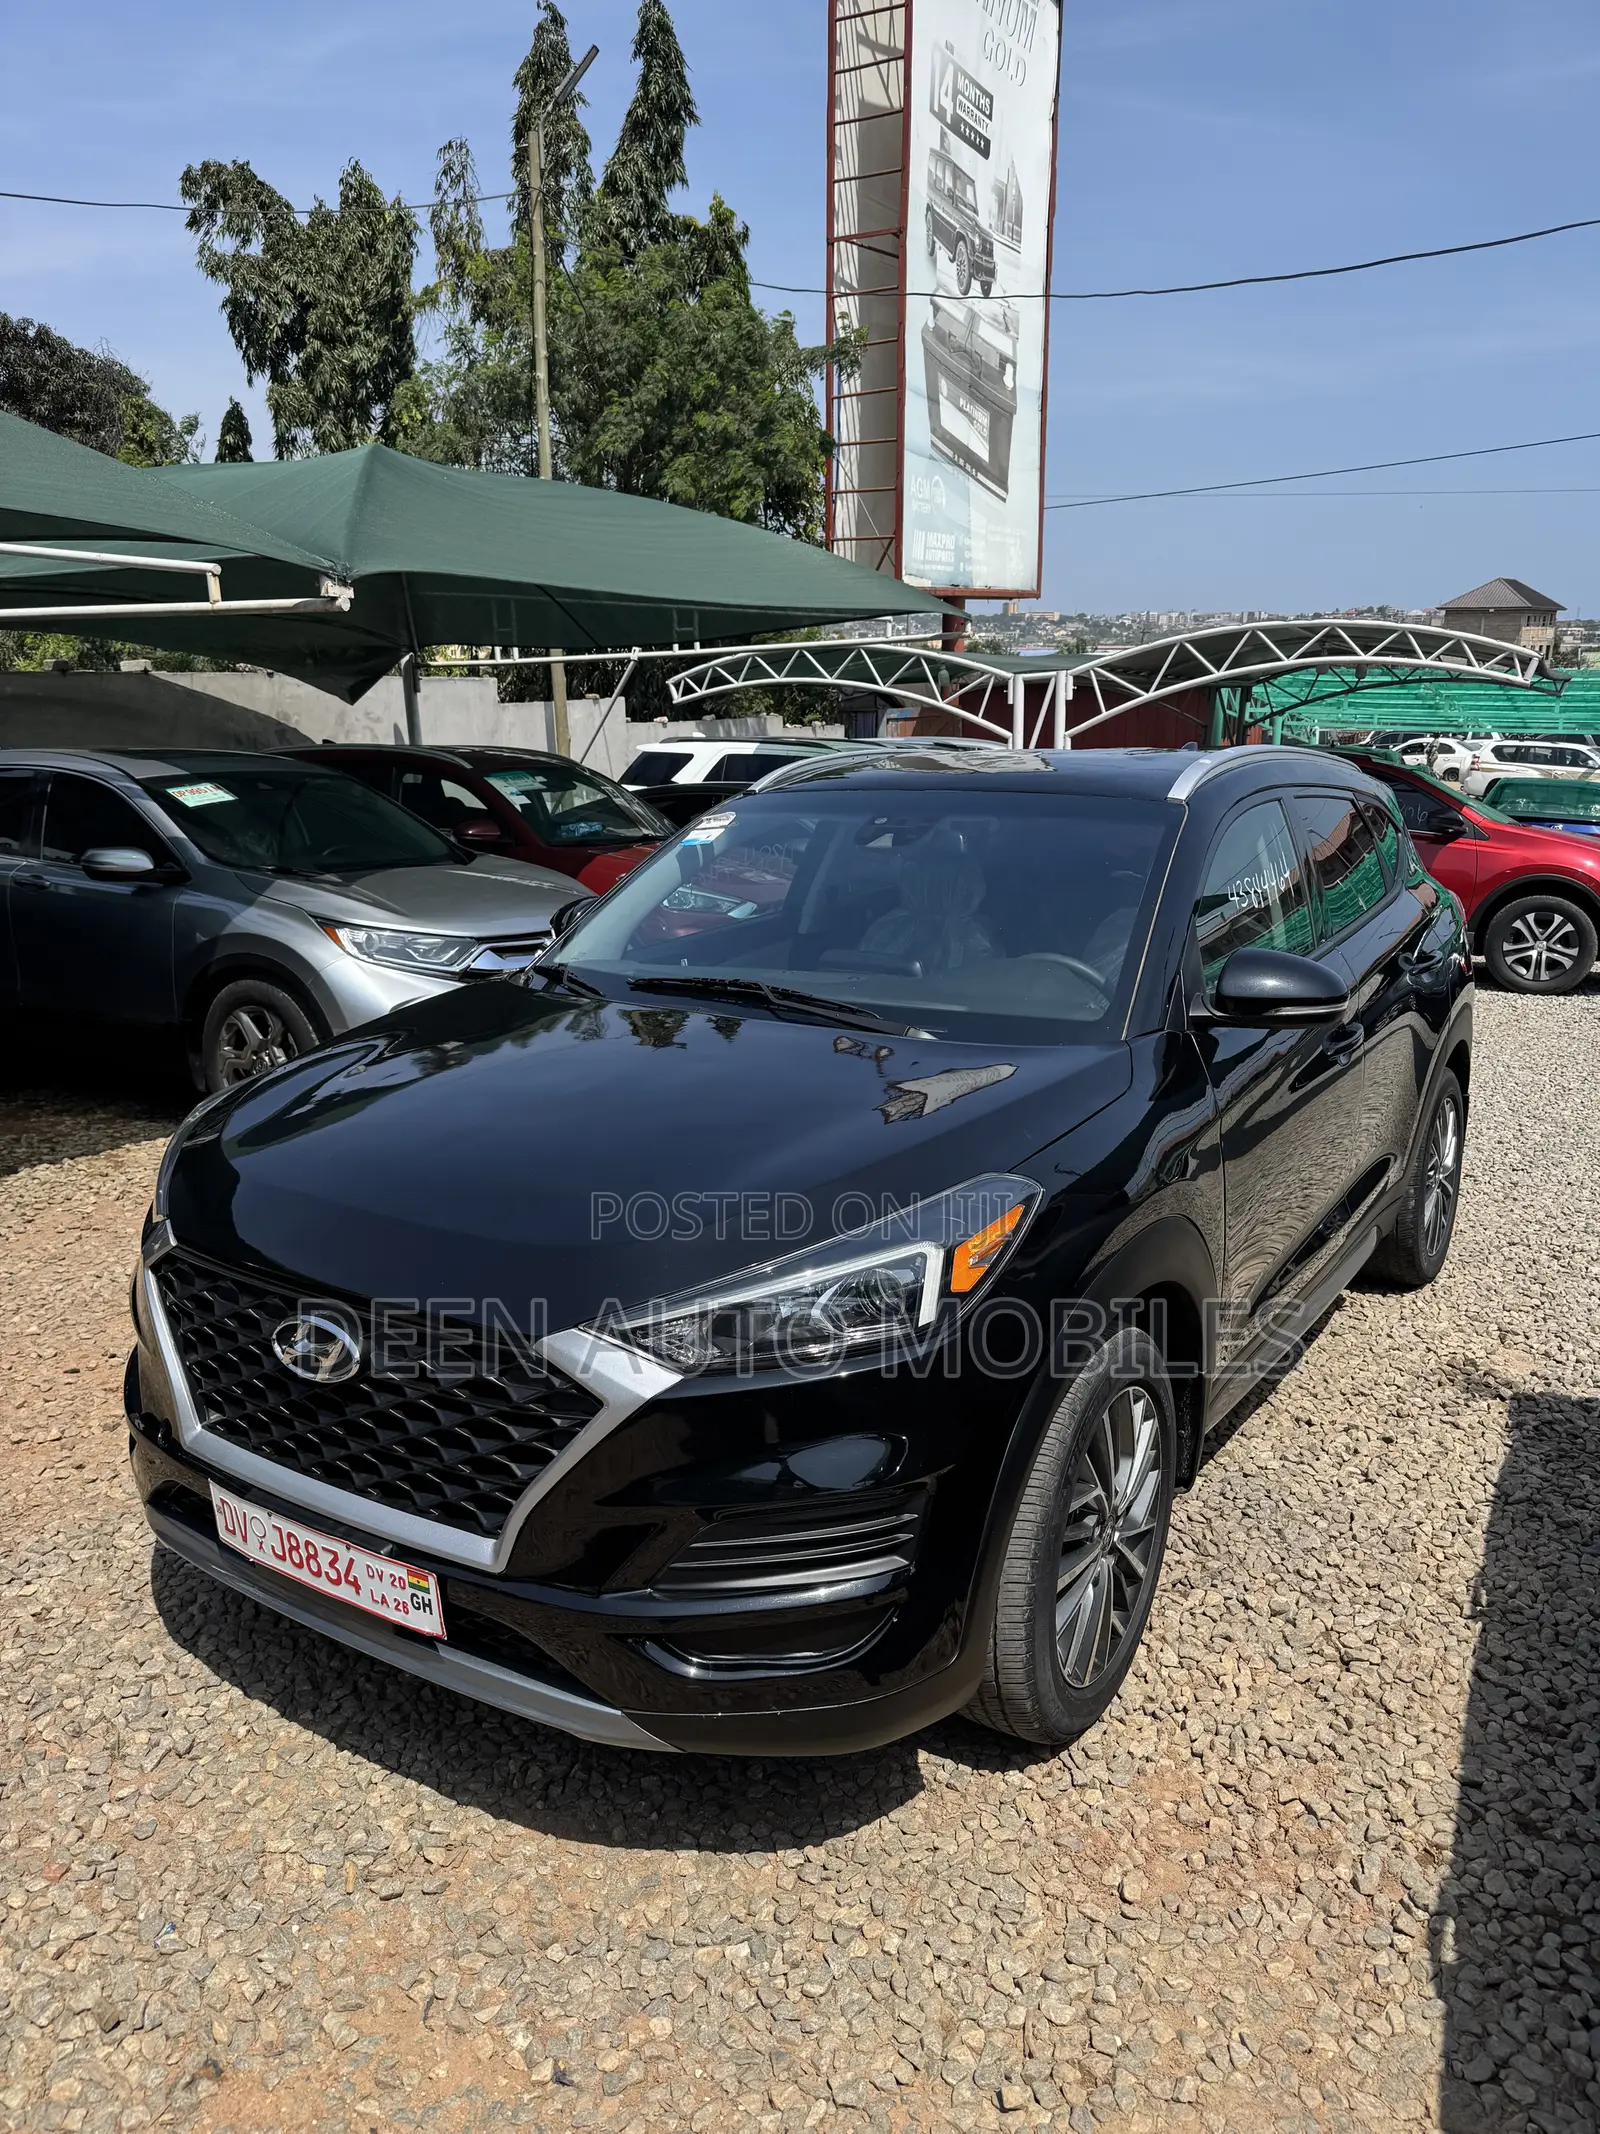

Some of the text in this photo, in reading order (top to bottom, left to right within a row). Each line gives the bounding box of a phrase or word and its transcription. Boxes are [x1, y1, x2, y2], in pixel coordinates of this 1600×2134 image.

[984, 28, 1027, 87] GOLD
[931, 44, 954, 125] 14
[957, 72, 991, 116] MONTHS
[957, 100, 989, 133] WARRANTY
[910, 475, 931, 500] AGM
[926, 531, 955, 550] MAXPRO
[219, 1496, 362, 1597] DV J8834
[365, 1561, 407, 1590] DV 20
[369, 1587, 391, 1609] LA
[410, 1592, 434, 1616] GH
